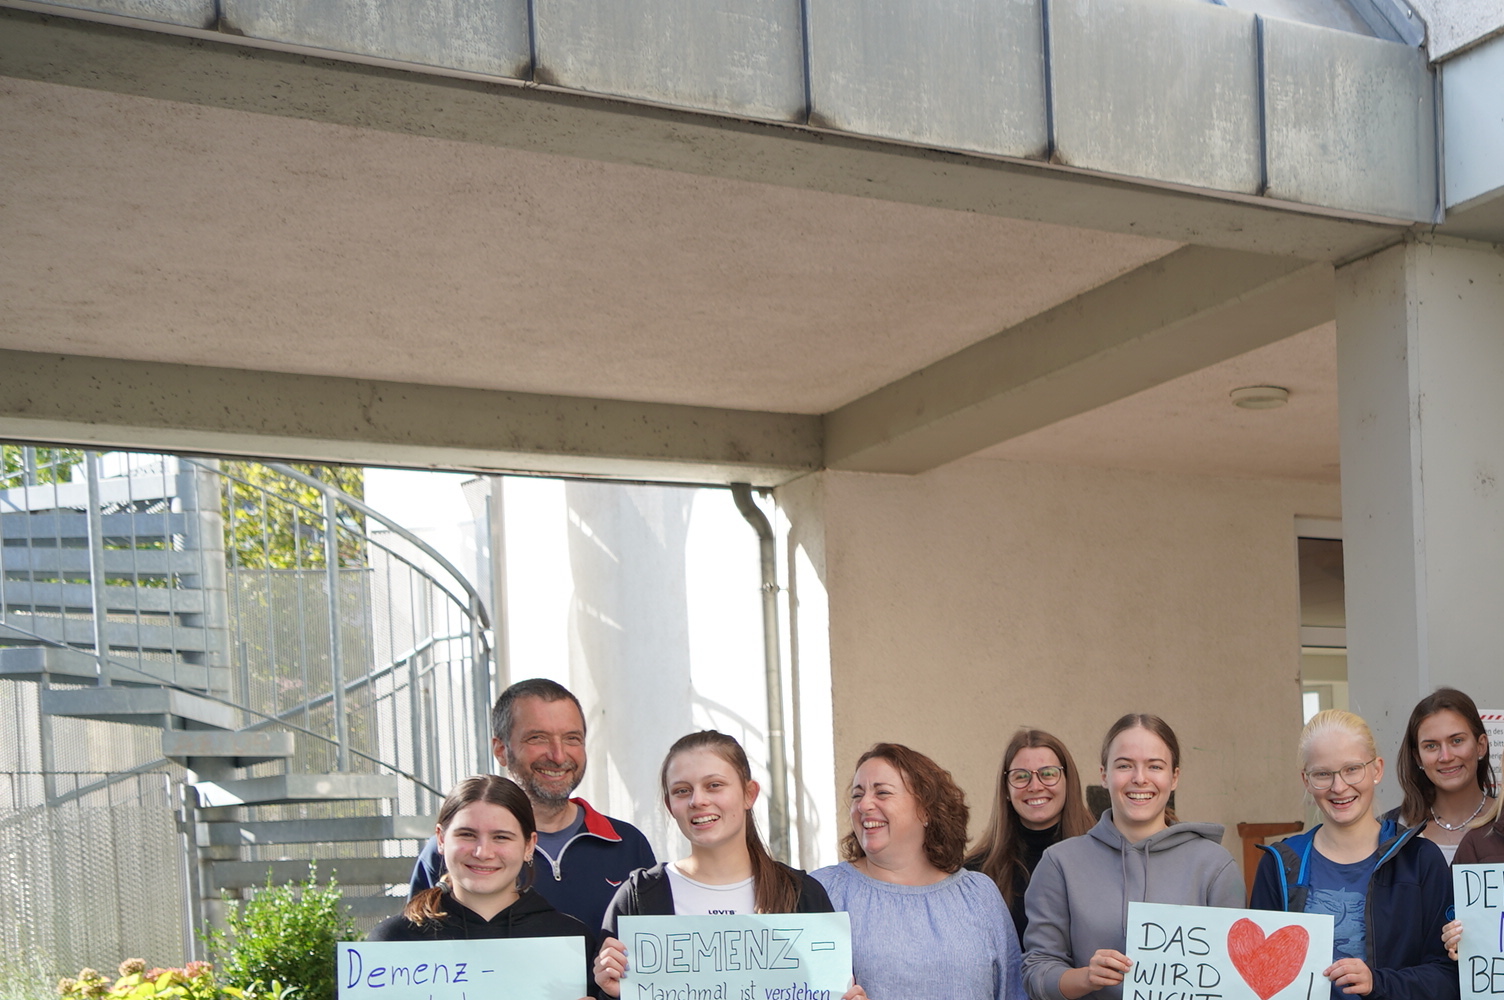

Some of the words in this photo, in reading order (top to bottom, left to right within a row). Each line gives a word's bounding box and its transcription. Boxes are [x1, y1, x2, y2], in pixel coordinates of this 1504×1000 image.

[634, 928, 804, 974] DEMENZ
[1138, 922, 1210, 956] DAS
[347, 949, 469, 989] Demenz
[1133, 961, 1221, 988] WIRD
[740, 980, 757, 1000] ist
